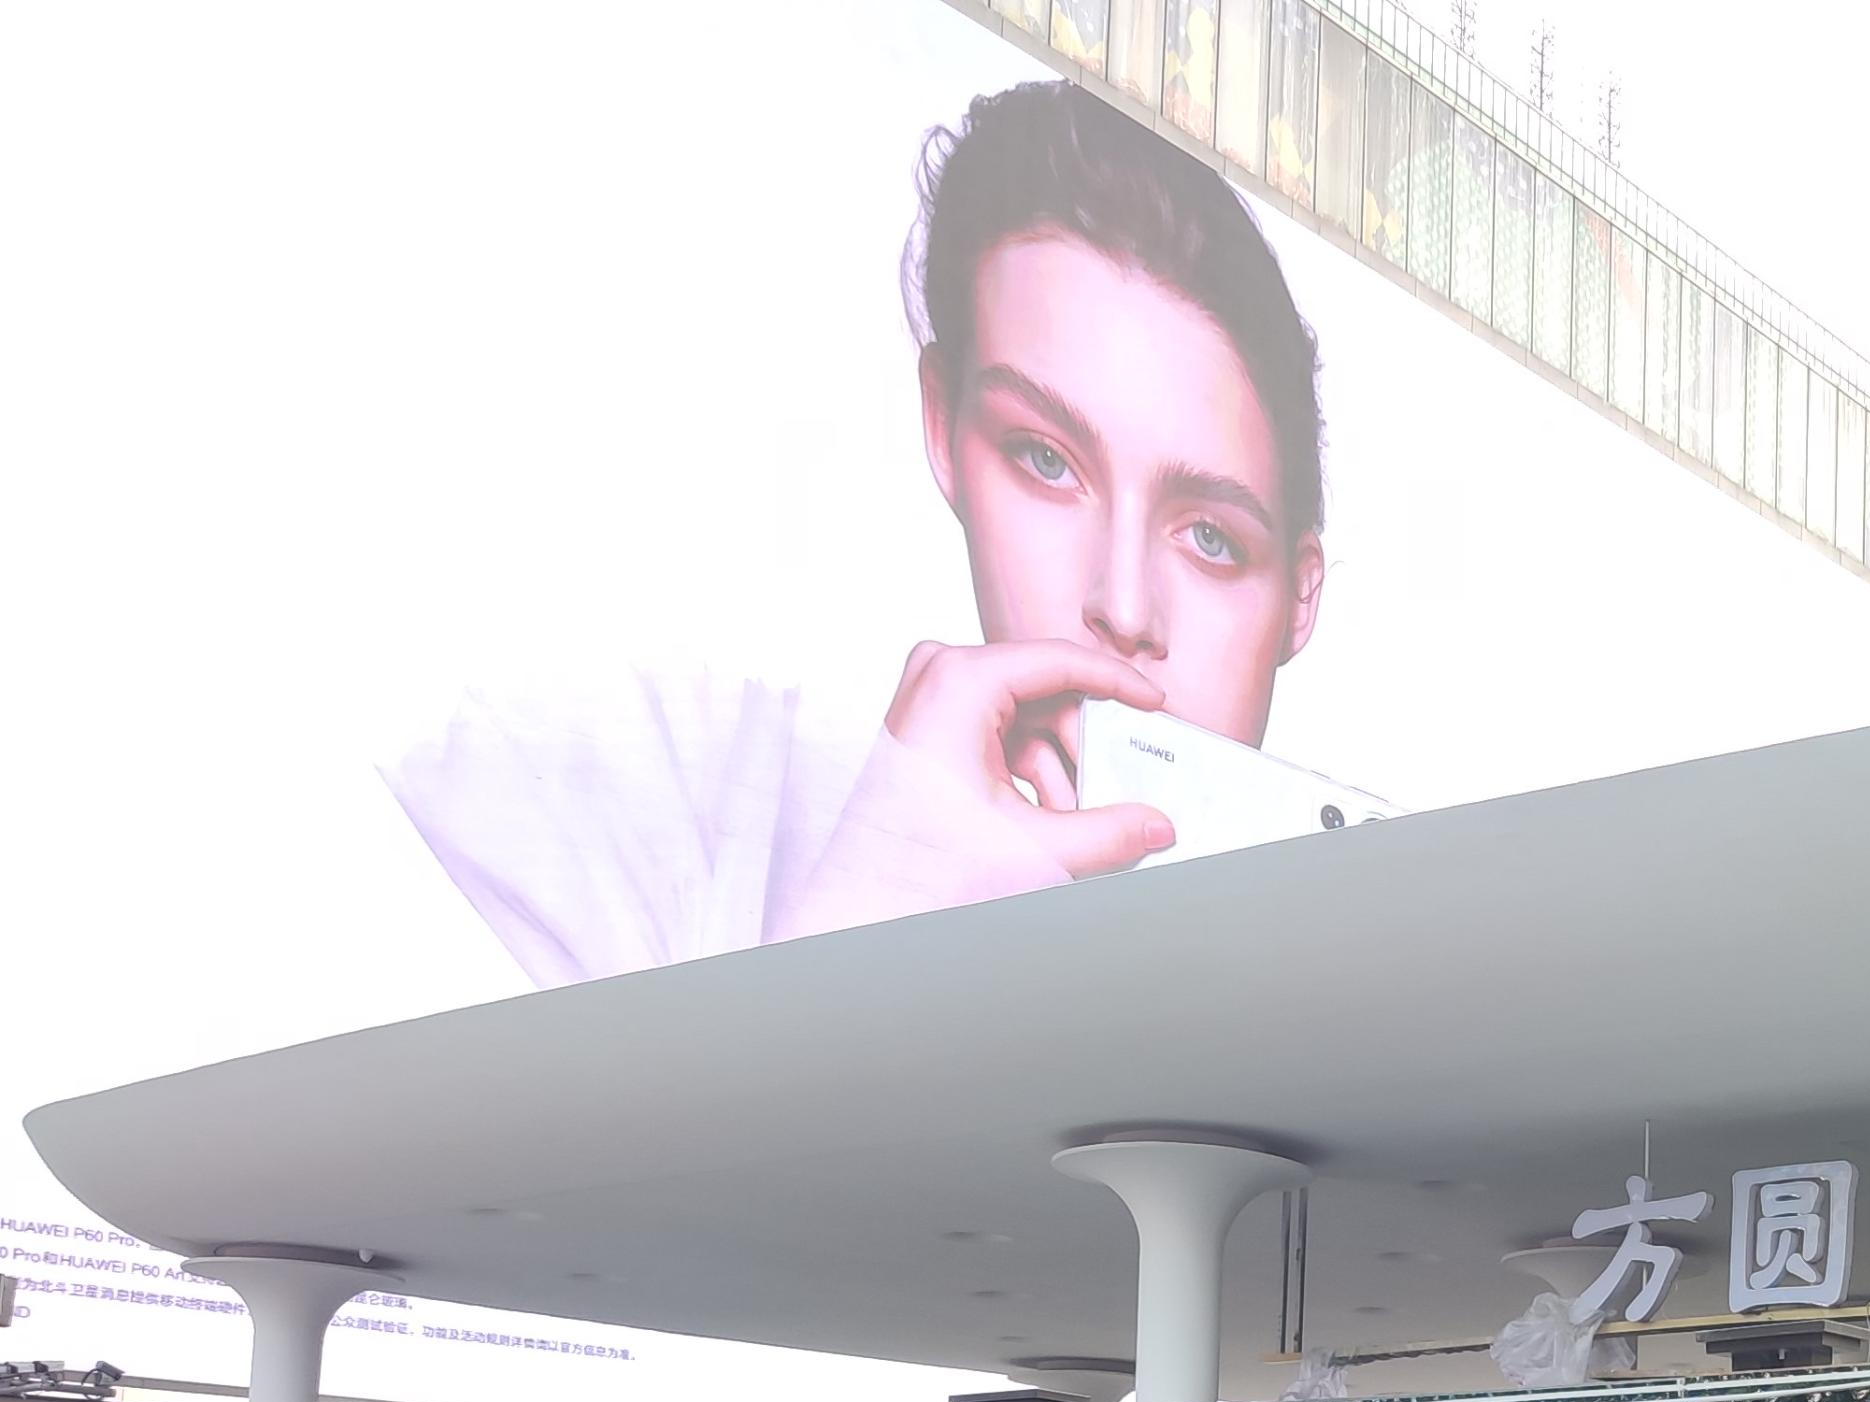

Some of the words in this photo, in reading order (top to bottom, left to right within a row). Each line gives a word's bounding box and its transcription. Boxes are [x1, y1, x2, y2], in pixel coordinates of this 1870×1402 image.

[1129, 736, 1175, 764] HUAWEI
[1, 1217, 69, 1238] HUAWEI
[74, 1227, 103, 1243] P60
[131, 1262, 160, 1278] P60
